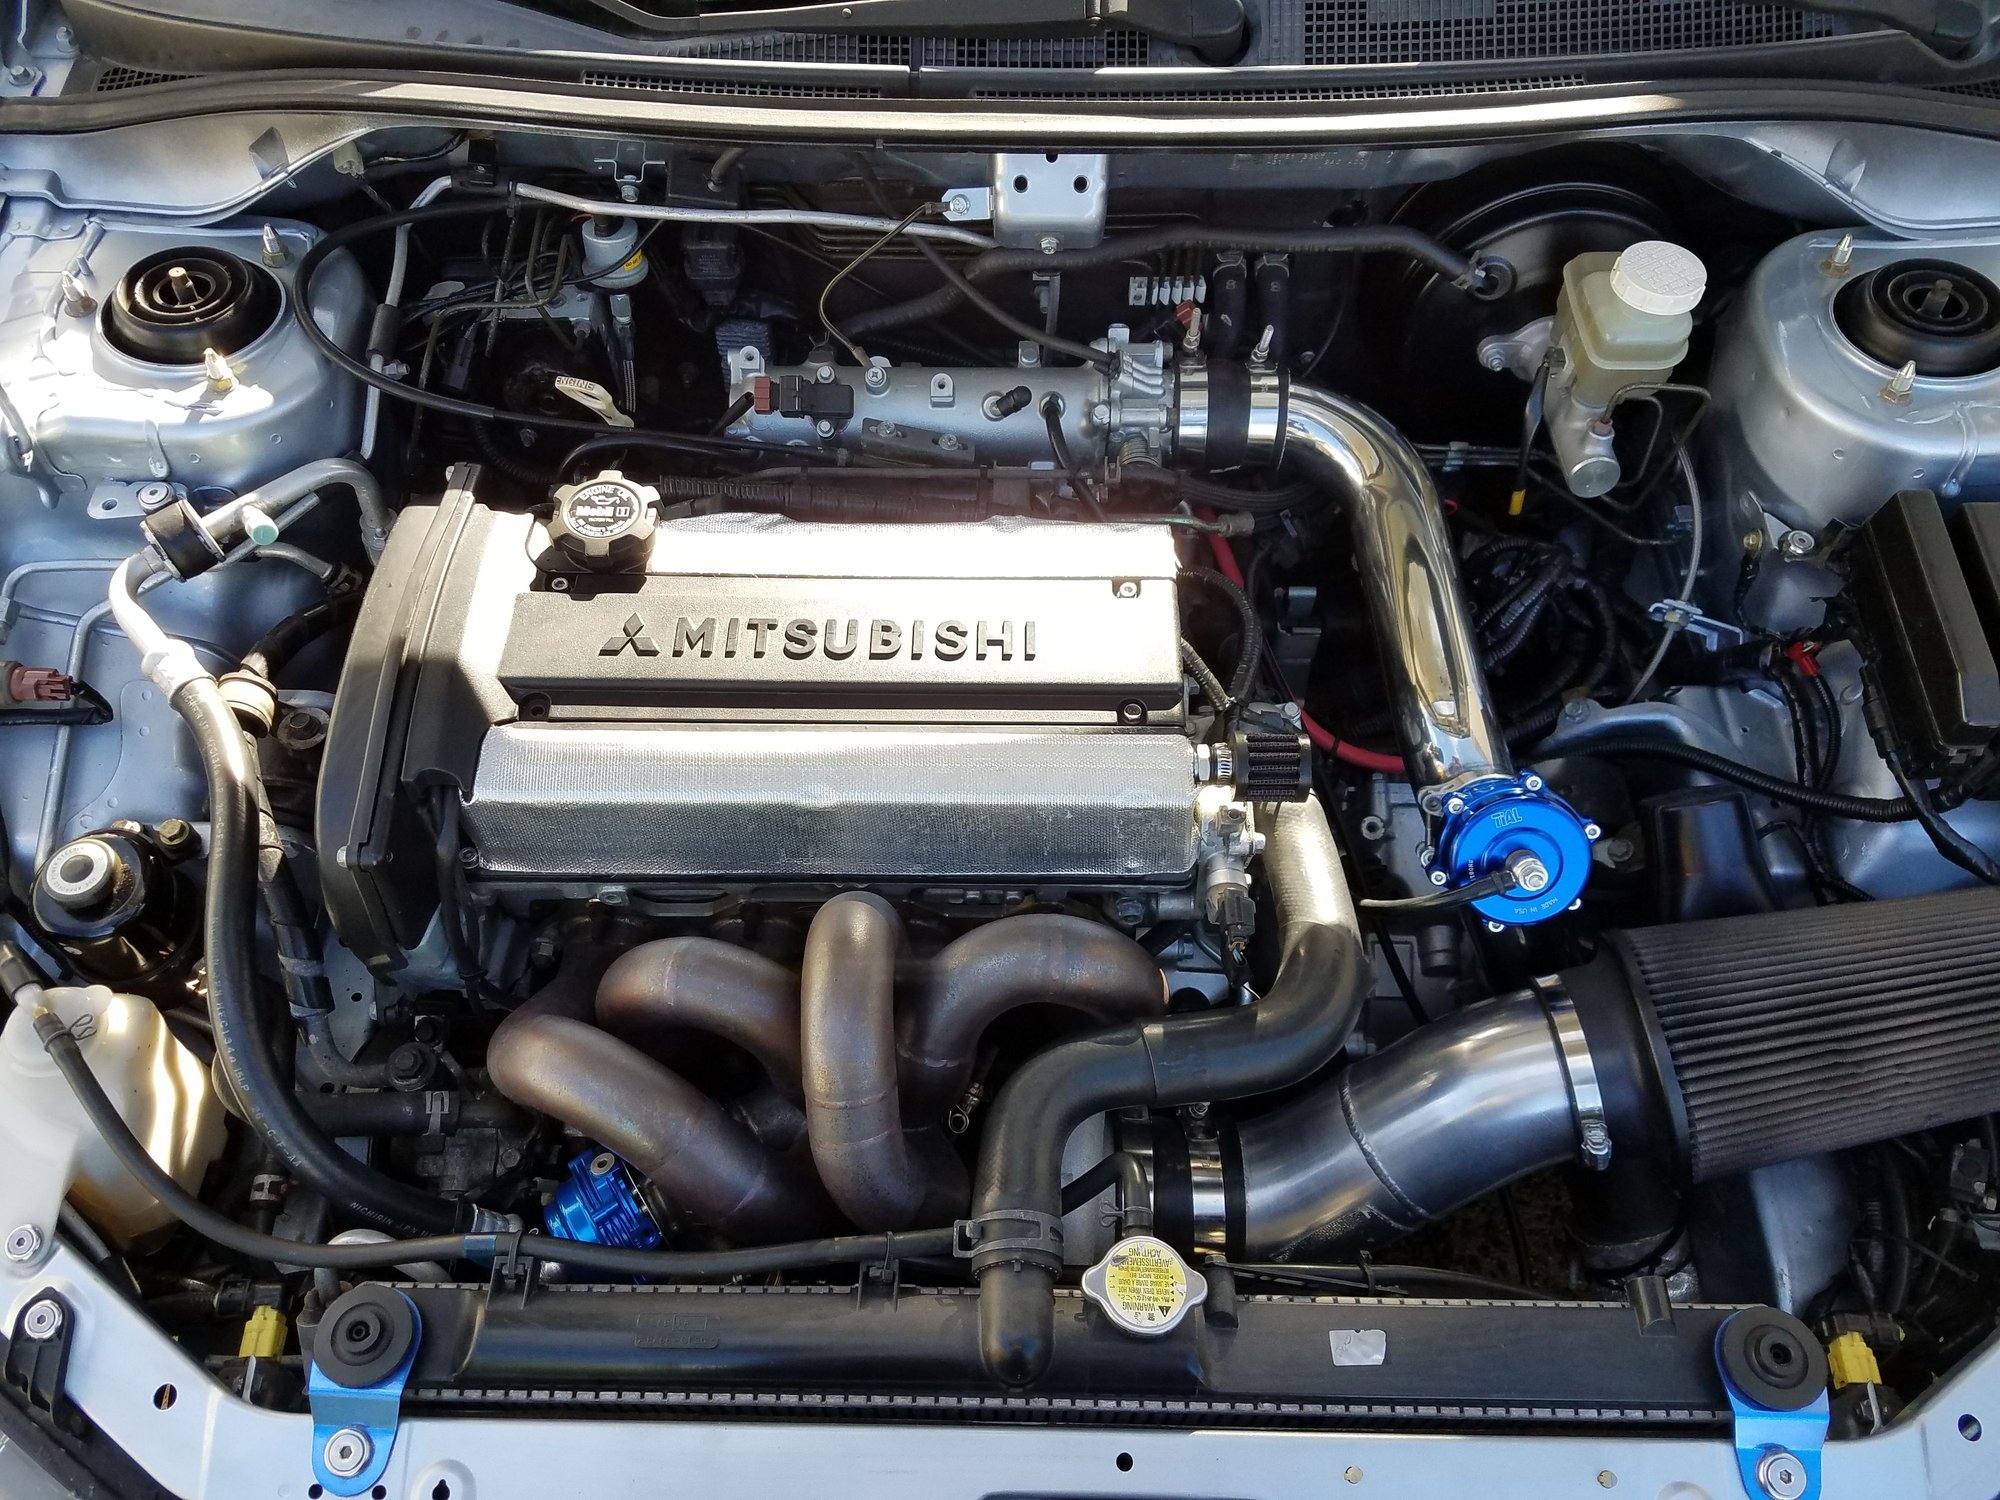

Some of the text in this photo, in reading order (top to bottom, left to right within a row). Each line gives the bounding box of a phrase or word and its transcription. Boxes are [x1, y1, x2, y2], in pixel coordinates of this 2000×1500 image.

[556, 376, 595, 391] ENGINE
[580, 485, 615, 501] ENGINE
[576, 505, 614, 517] Mobil
[671, 616, 1039, 663] MITSUBISHI
[350, 1201, 393, 1225] NICHIRIN
[1122, 1258, 1170, 1267] AVERTISSEMEN
[1122, 1302, 1155, 1311] WARNING
